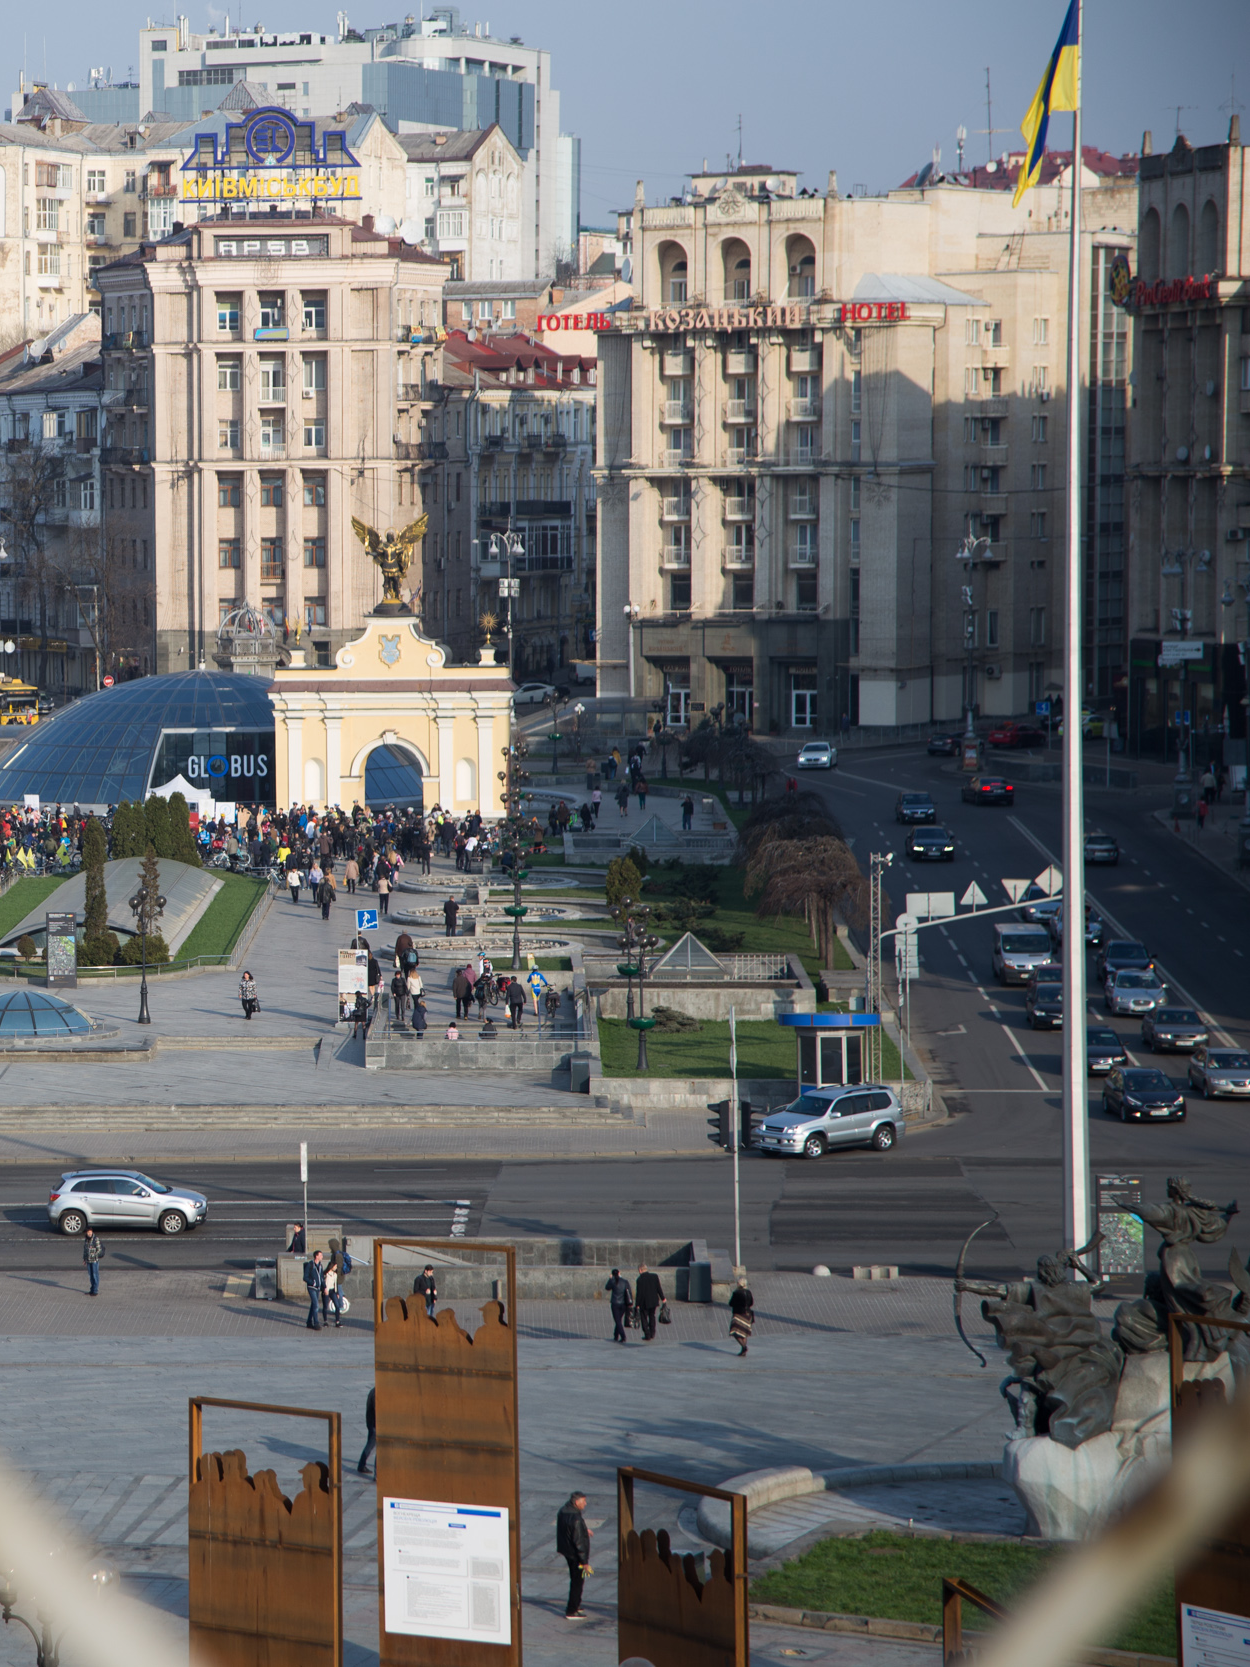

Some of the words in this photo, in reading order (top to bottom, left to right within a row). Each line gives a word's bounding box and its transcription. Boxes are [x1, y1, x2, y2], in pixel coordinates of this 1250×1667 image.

[182, 174, 361, 199] КИЇВМІСЬКБУД
[537, 312, 611, 332] ГОТЕЛЬ
[649, 302, 801, 334] КОЗАЦЬКИЙ
[840, 301, 911, 322] HOTEL
[188, 754, 268, 778] GLOBUS
